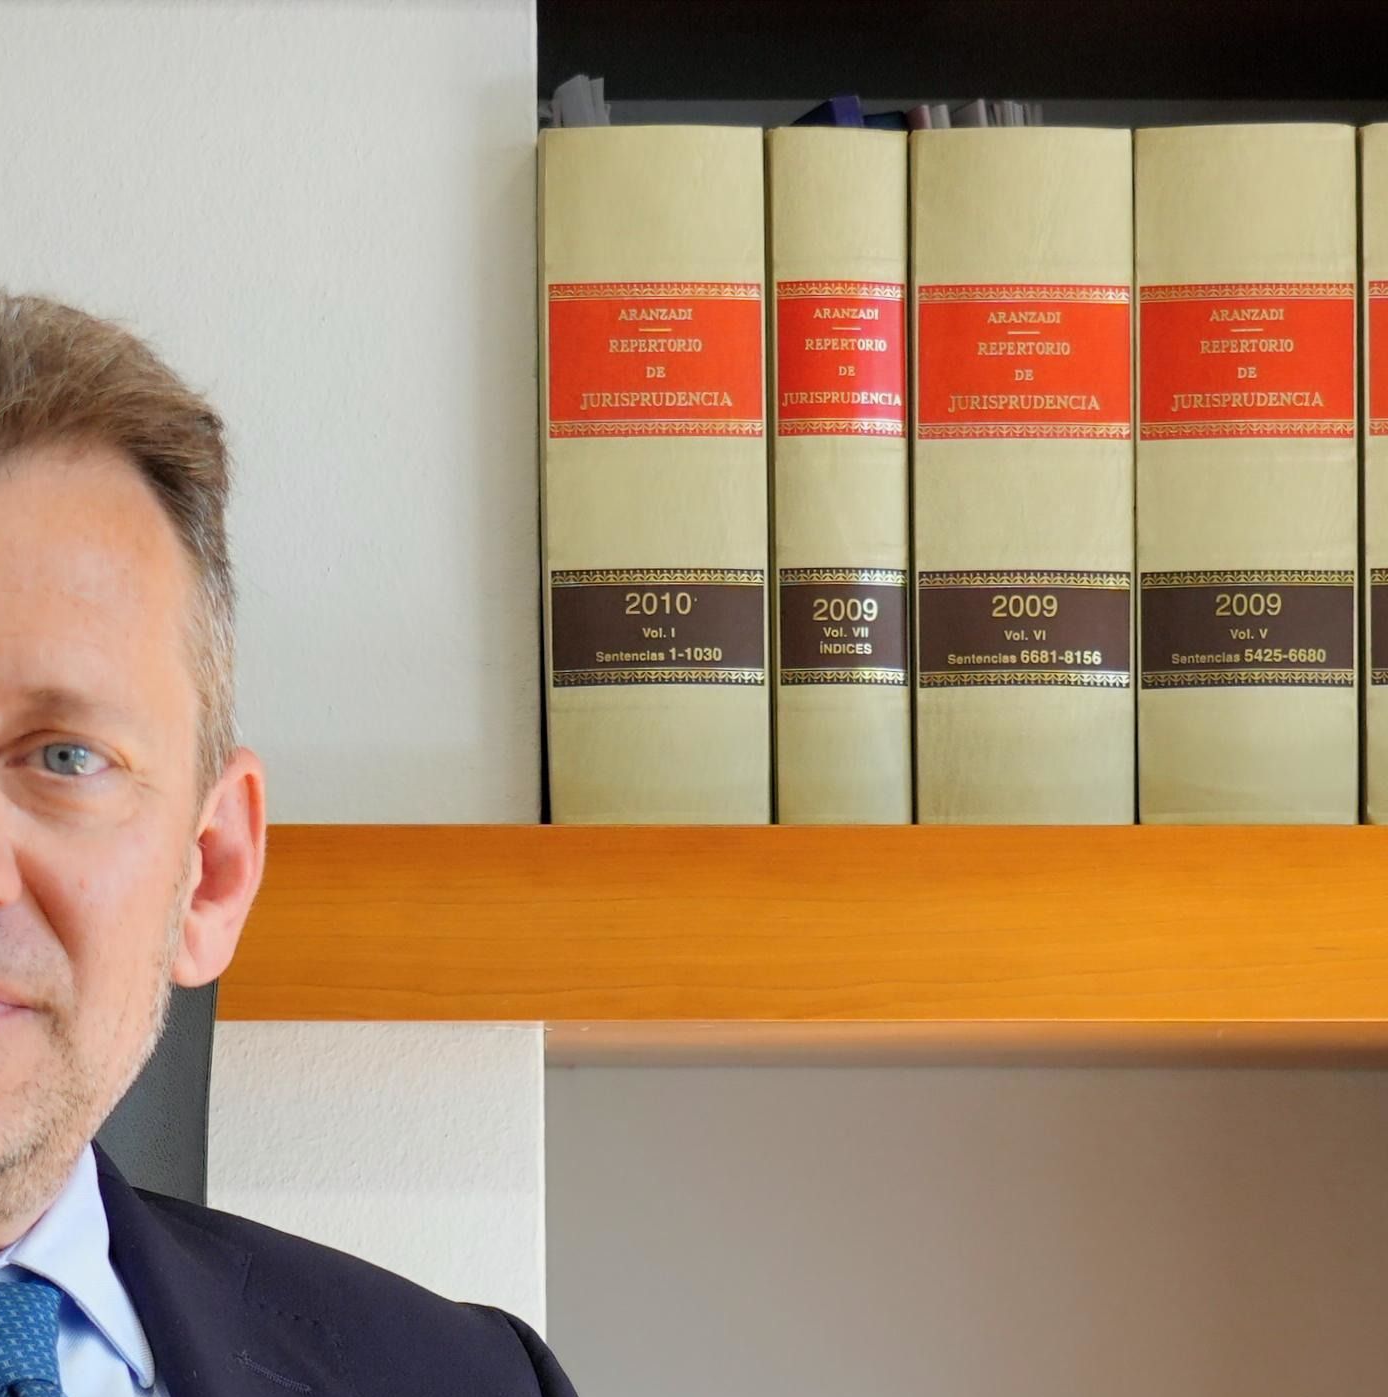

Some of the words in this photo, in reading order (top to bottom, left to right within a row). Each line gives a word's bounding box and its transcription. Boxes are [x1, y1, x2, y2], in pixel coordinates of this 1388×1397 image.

[618, 308, 693, 321] ARANZADI
[813, 307, 879, 320] ARANZADI
[987, 311, 1062, 324] ARANZADI
[1209, 308, 1284, 321] ARANZADI
[608, 339, 702, 353] REPERTORIO
[805, 338, 887, 352] REPERTORIO
[977, 342, 1071, 356] REPERTORIO
[1200, 339, 1294, 353] REPERTORIO
[646, 367, 665, 377] DE
[839, 366, 856, 376] DE
[1015, 370, 1034, 381] DE
[1237, 367, 1257, 378] DE
[580, 392, 733, 410] JURISPRUDENCIA
[782, 392, 902, 407] JURISPRUDENCIA
[948, 395, 1100, 414] JURISPRUDENCIA
[1171, 391, 1323, 412] JURISPRUDENCIA
[624, 593, 693, 615] 2010
[813, 599, 878, 622] 2009
[991, 595, 1058, 618] 2009
[1215, 594, 1282, 617] 2009
[642, 627, 668, 639] Vol.
[671, 627, 676, 638] I
[823, 627, 849, 638] Vol.
[852, 627, 869, 638] VII
[1004, 630, 1031, 641] Vol.
[1034, 630, 1046, 641] VI
[1230, 629, 1257, 640] Vol.
[1259, 629, 1267, 639] V
[595, 651, 665, 662] Sentencias
[668, 647, 722, 662] 1-1030
[819, 641, 872, 655] ÍNDICES
[948, 653, 1017, 664] Sentencias
[1020, 650, 1102, 665] 6681-8156
[1172, 652, 1241, 664] Sentencias
[1244, 648, 1326, 664] 5425-6680
